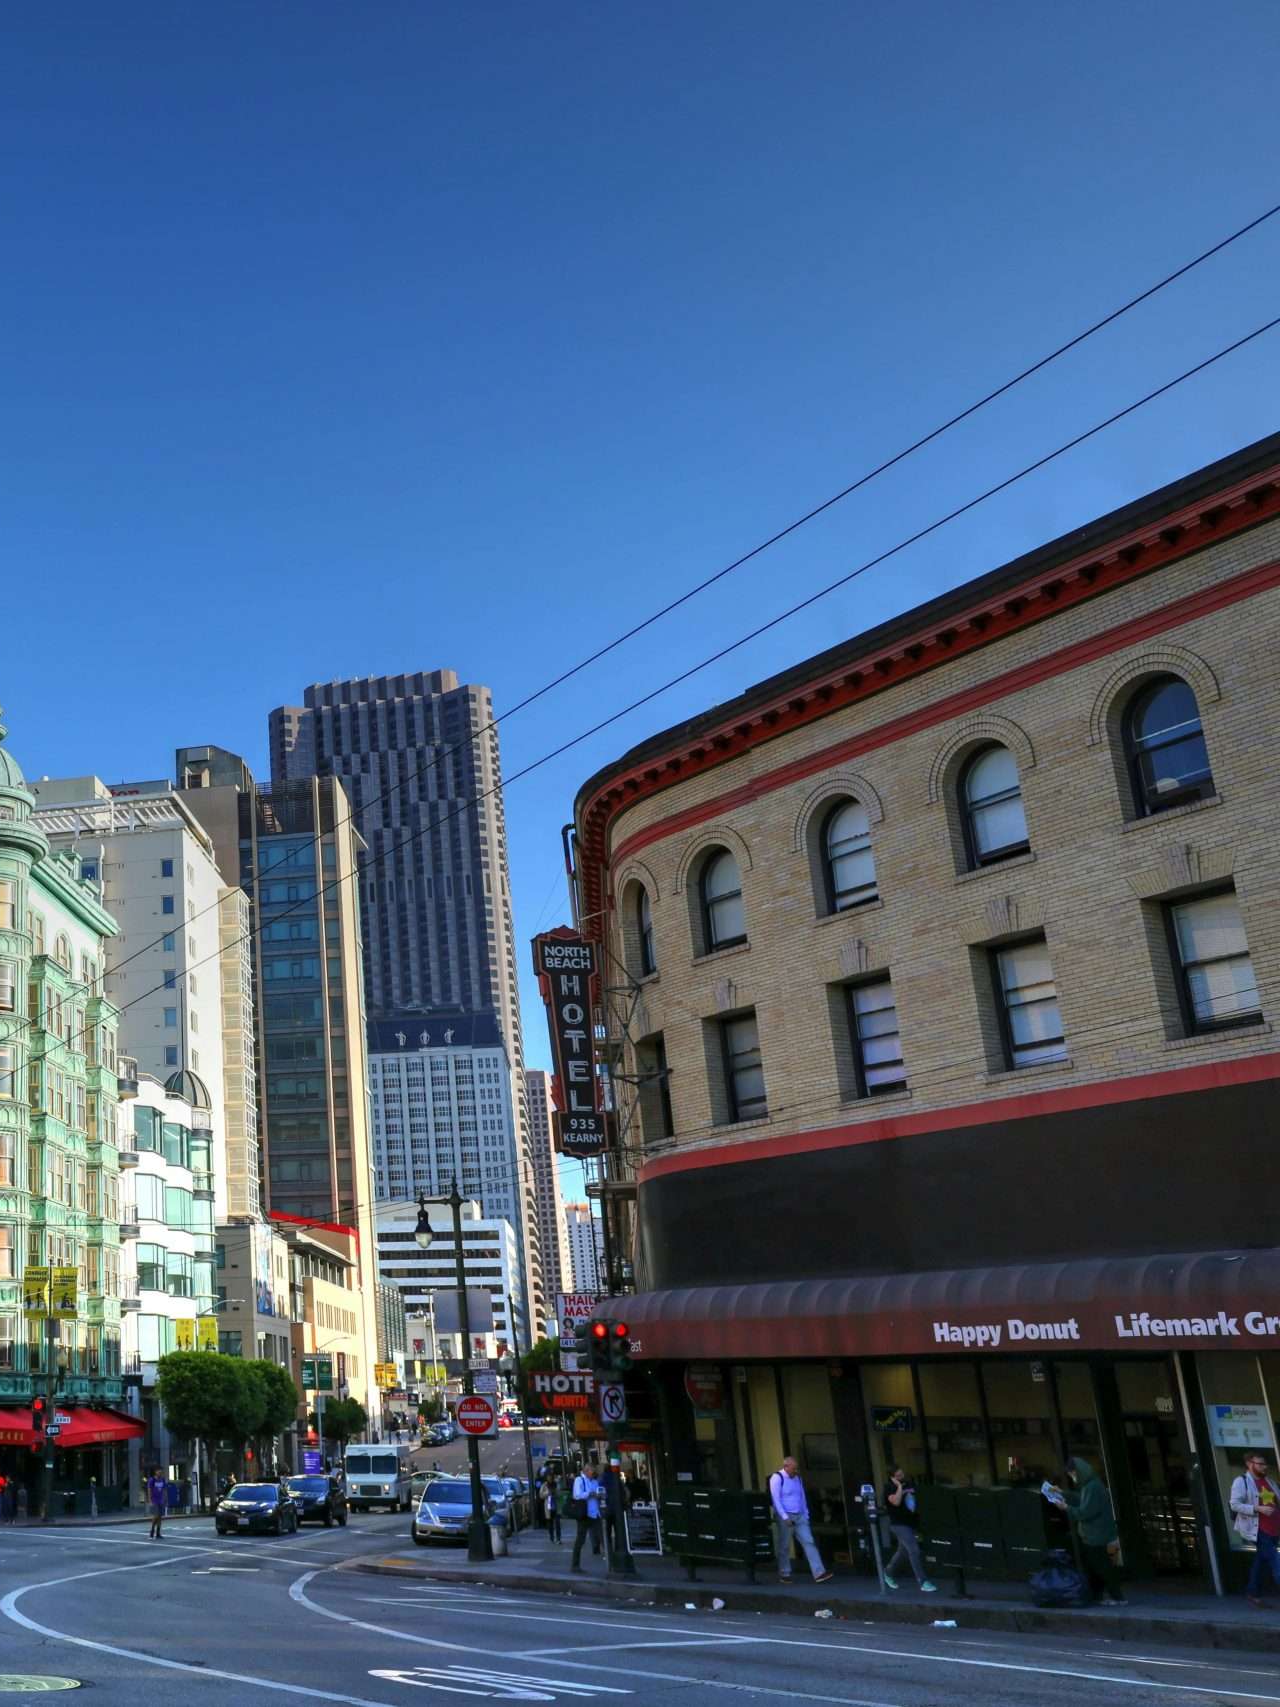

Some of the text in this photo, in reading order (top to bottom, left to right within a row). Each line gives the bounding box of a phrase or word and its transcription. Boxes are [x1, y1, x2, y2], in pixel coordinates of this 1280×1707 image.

[544, 946, 590, 957] NORTH
[545, 957, 591, 969] BEACH
[560, 974, 593, 1112] HOTEL
[570, 1118, 596, 1130] 935
[563, 1132, 604, 1143] KEARNY
[1114, 1311, 1280, 1338] Lifemark Gr
[932, 1317, 1081, 1347] Happy Donut
[535, 1374, 595, 1393] HOTE
[552, 1394, 589, 1408] NORTH
